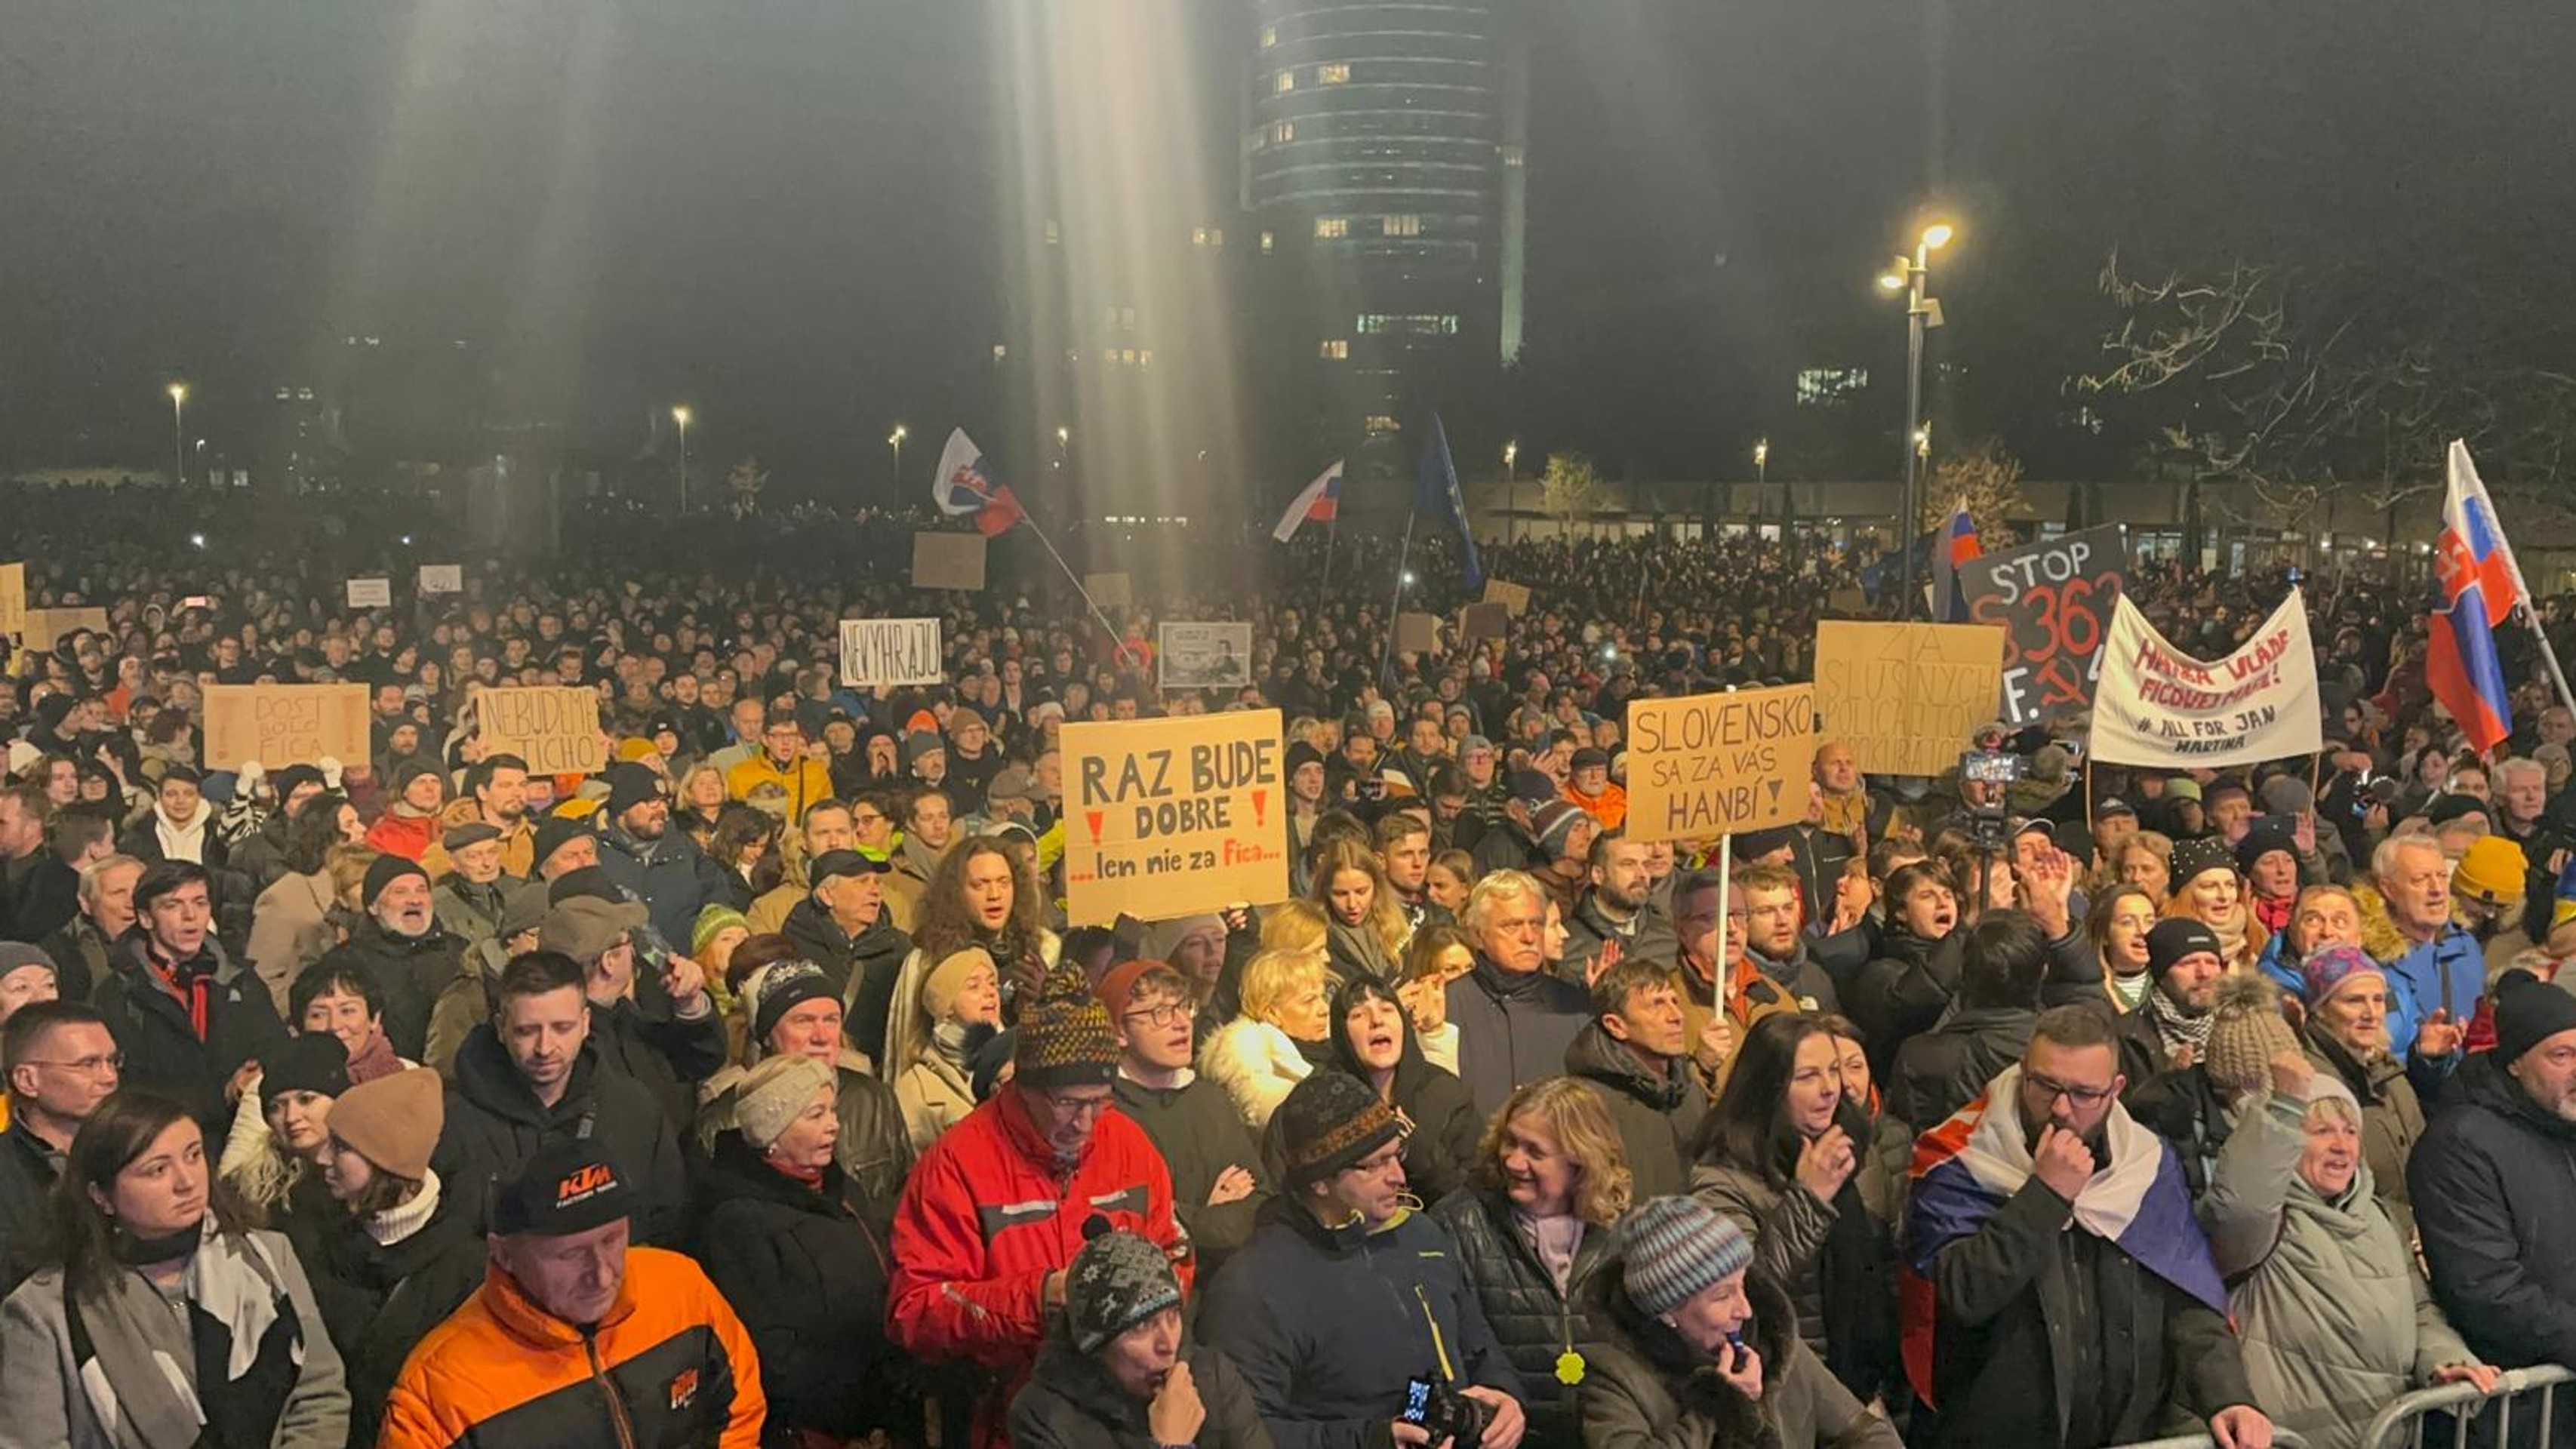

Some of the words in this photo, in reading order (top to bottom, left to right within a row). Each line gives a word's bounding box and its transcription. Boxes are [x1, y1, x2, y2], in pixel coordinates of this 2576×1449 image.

[1990, 541, 2090, 605] STOP
[1878, 625, 1947, 663] ZA
[485, 688, 596, 737] NEBUDEME
[1636, 694, 1812, 754] SLOVENSKO
[2194, 719, 2228, 737] FOR
[2234, 705, 2276, 732] JAN
[260, 737, 325, 764] FICA
[512, 736, 594, 773] TICHO
[1651, 759, 1682, 788] SA
[1691, 755, 1725, 782] ZA
[1731, 743, 1777, 774] VÁS
[1082, 749, 1174, 806] RAZ
[1191, 738, 1277, 793] BUDE
[1135, 795, 1232, 839] DOBRE
[1146, 848, 1183, 875] nie
[1189, 849, 1217, 871] za
[558, 1163, 614, 1199] KTM
